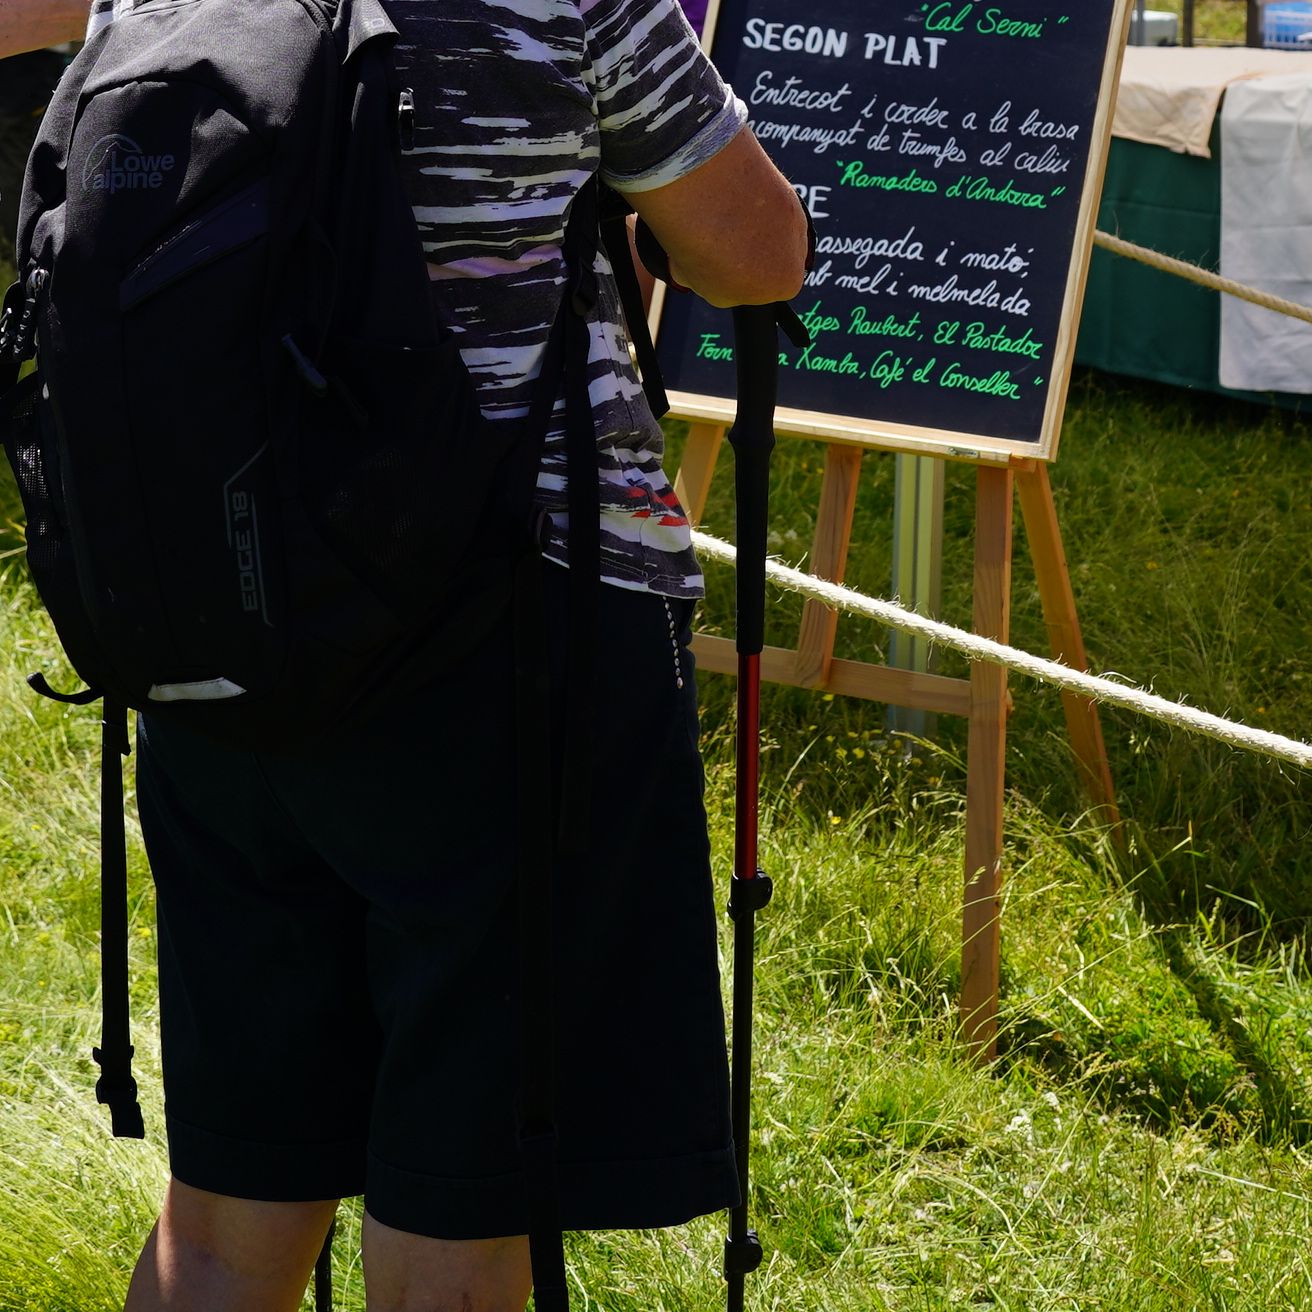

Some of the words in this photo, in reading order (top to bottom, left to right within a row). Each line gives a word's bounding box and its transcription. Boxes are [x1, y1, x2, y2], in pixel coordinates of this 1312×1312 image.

[742, 17, 848, 58] SEGON
[864, 33, 948, 70] PLAT
[749, 70, 852, 113] Entrecot
[861, 94, 877, 119] i
[884, 97, 948, 128] corder
[962, 110, 977, 130] a
[989, 100, 1012, 134] la
[1018, 109, 1079, 140] brasa
[111, 151, 175, 171] Lowe
[867, 124, 892, 151] de
[898, 128, 967, 168] trumfes
[979, 142, 1012, 166] al
[1014, 144, 1072, 174] caliu
[93, 169, 162, 193] alpine
[936, 240, 954, 266] i
[835, 264, 892, 294] mel
[886, 272, 904, 295] i
[933, 321, 961, 344] El
[961, 322, 1043, 359] Pastador
[696, 334, 734, 361] Forn
[912, 358, 936, 383] el
[232, 491, 249, 521] 18
